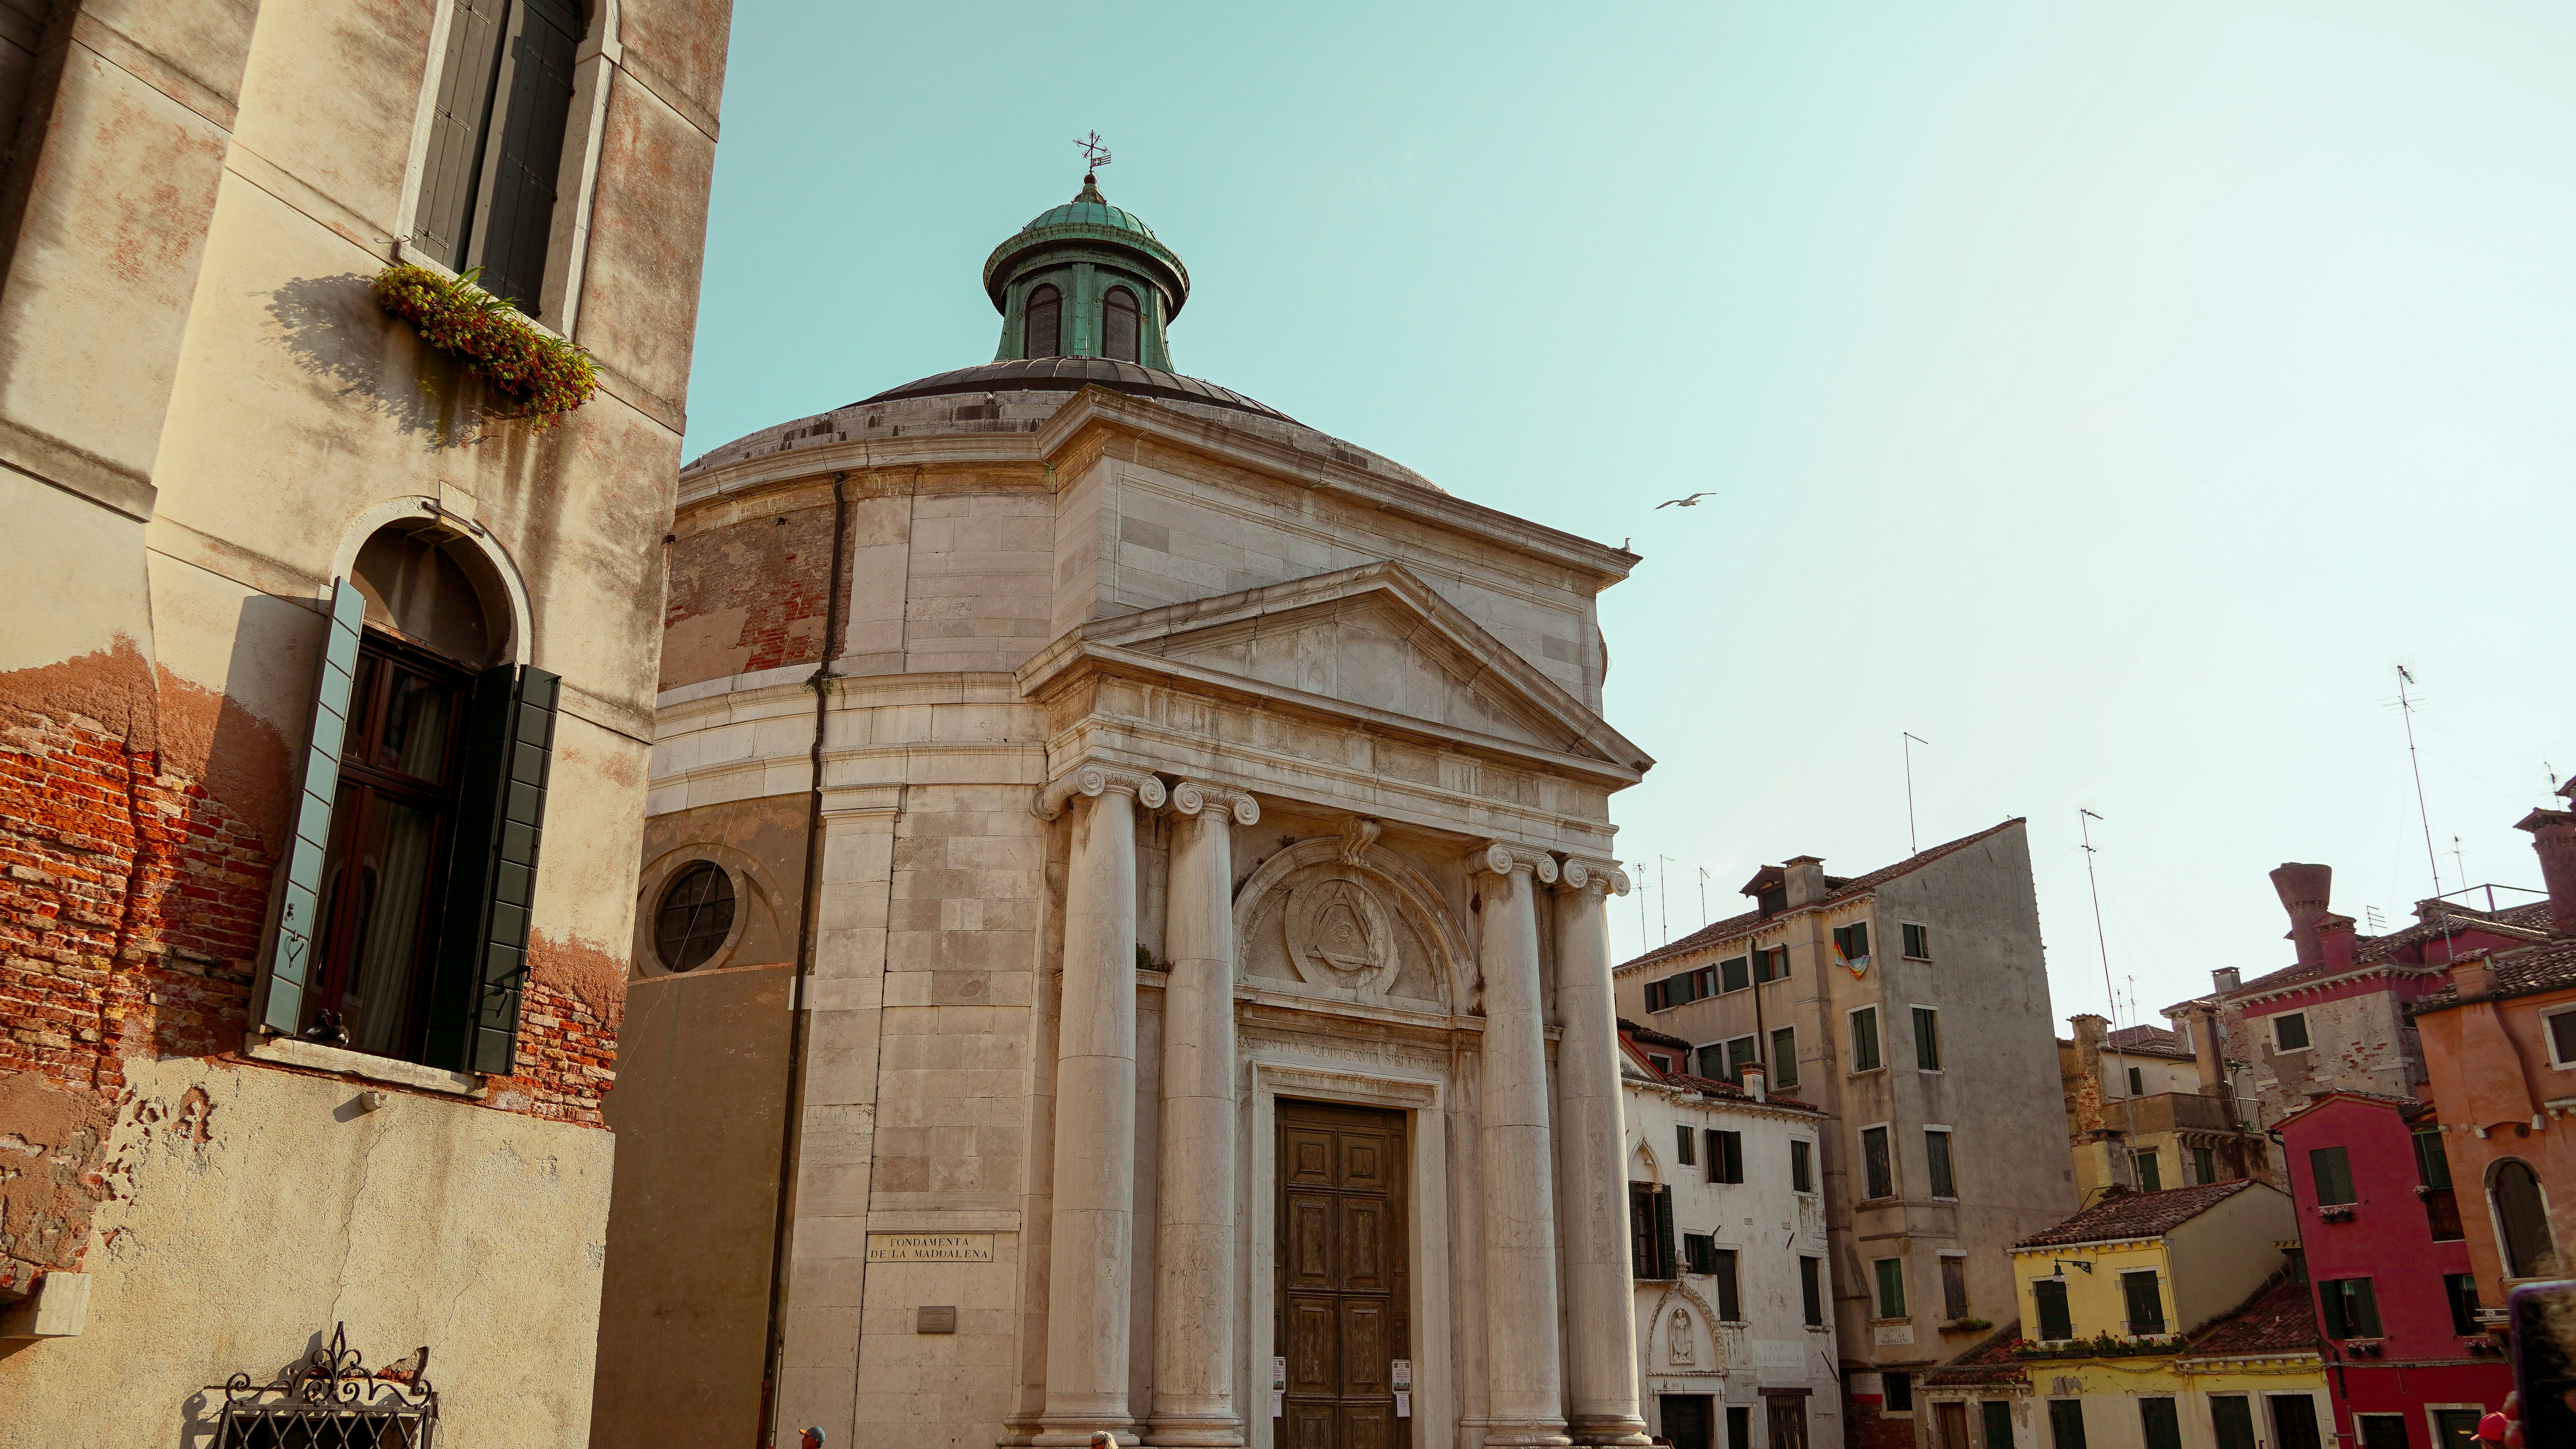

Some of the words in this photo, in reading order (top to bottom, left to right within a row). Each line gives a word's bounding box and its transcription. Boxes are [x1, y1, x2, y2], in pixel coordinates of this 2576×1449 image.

[890, 1237, 969, 1247] FONDAMENTA
[870, 1249, 886, 1258] DE
[892, 1249, 906, 1258] LA
[913, 1249, 988, 1258] MADDALENA
